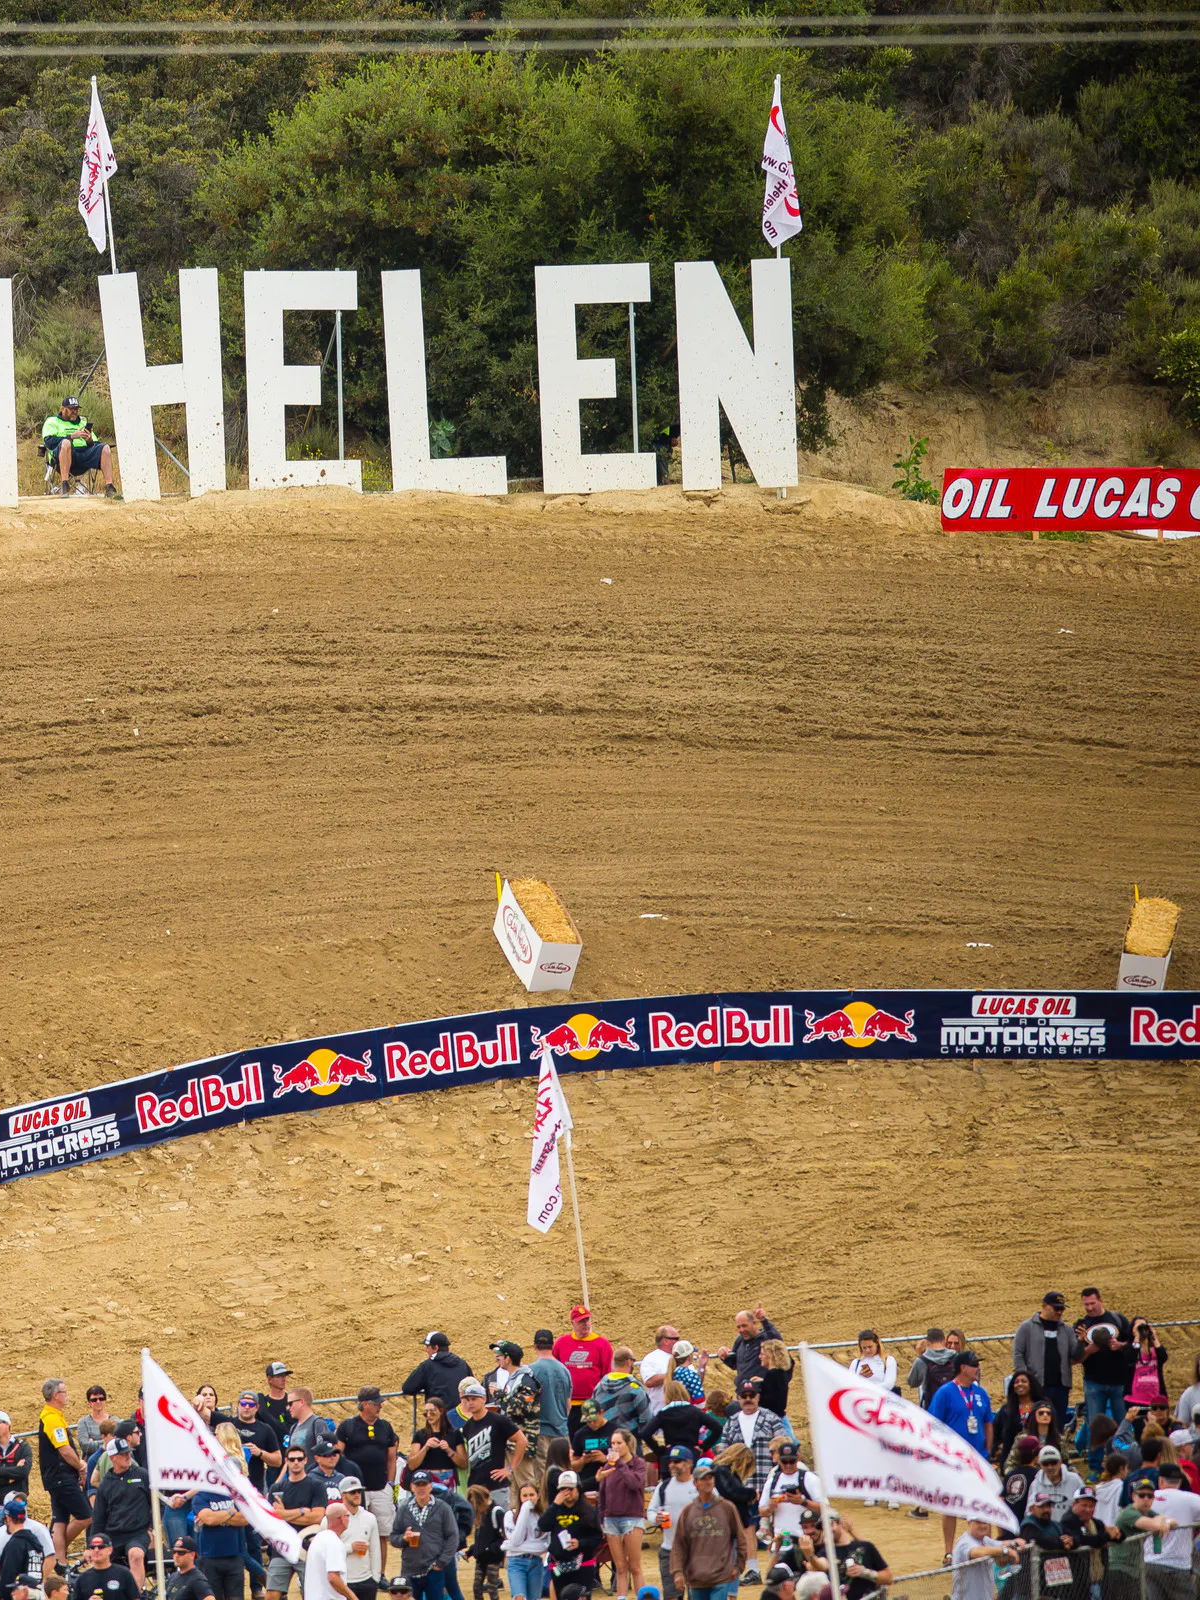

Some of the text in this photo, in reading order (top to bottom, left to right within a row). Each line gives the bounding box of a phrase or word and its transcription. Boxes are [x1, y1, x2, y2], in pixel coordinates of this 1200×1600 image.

[98, 257, 799, 501] HELEN
[941, 477, 1012, 520] OIL
[1032, 476, 1182, 520] LUCAS
[976, 997, 1073, 1016] LUCAS OIL
[1001, 1017, 1047, 1026] PRO
[940, 1026, 1106, 1047] MOTOCROSS
[940, 1046, 1107, 1055] CHAMPIONSHIP
[13, 1100, 87, 1135] LUCAS OIL
[34, 1125, 69, 1142] PRO
[467, 1425, 493, 1456] FOX
